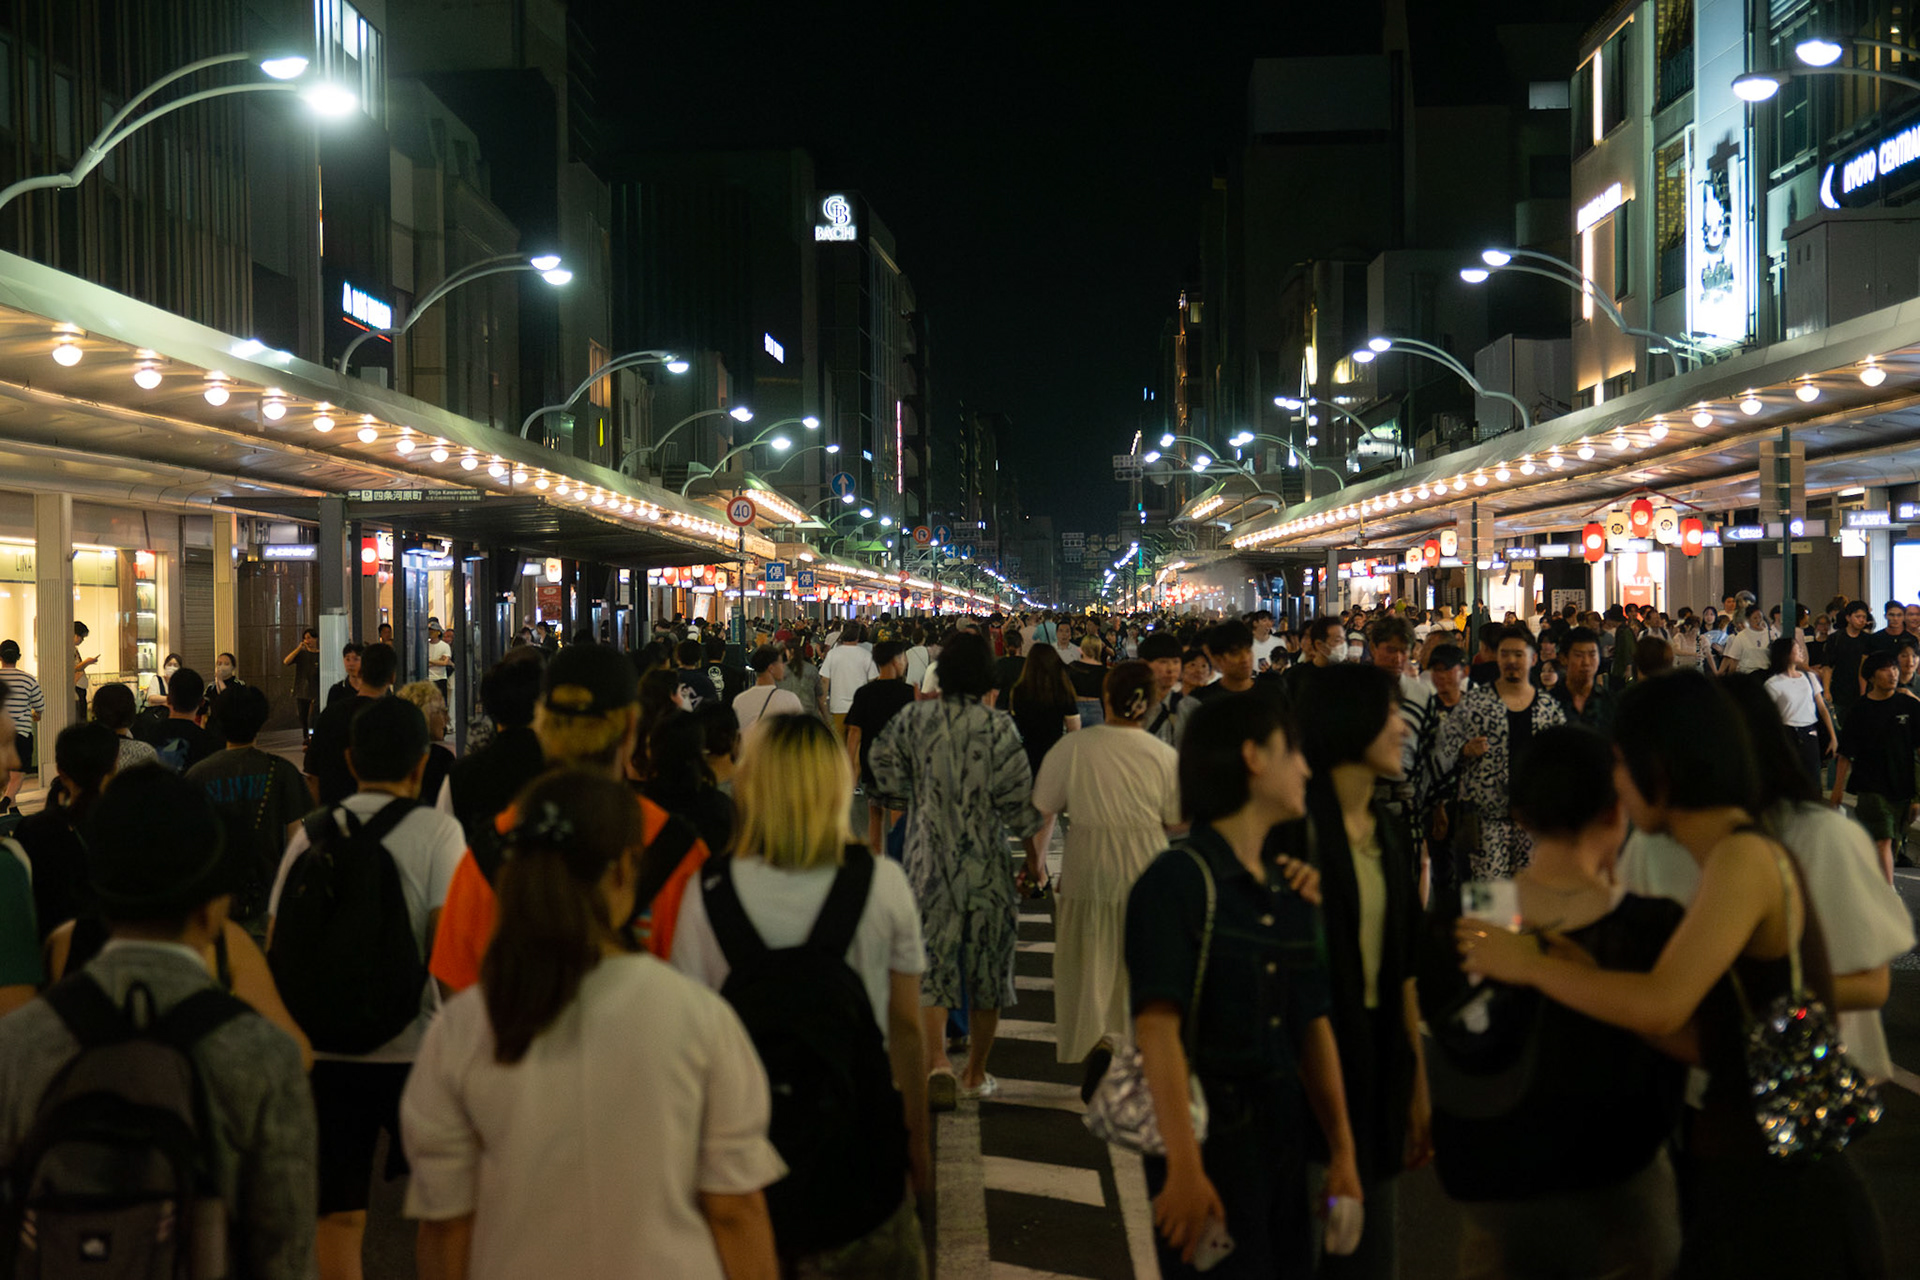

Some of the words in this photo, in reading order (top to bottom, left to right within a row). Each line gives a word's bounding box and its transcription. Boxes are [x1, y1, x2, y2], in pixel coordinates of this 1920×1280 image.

[1843, 147, 1877, 193] KYOTO
[815, 225, 857, 241] BACH
[373, 490, 422, 501] 四条河原町
[733, 504, 750, 519] 40
[768, 565, 783, 580] 停
[799, 573, 813, 586] 停
